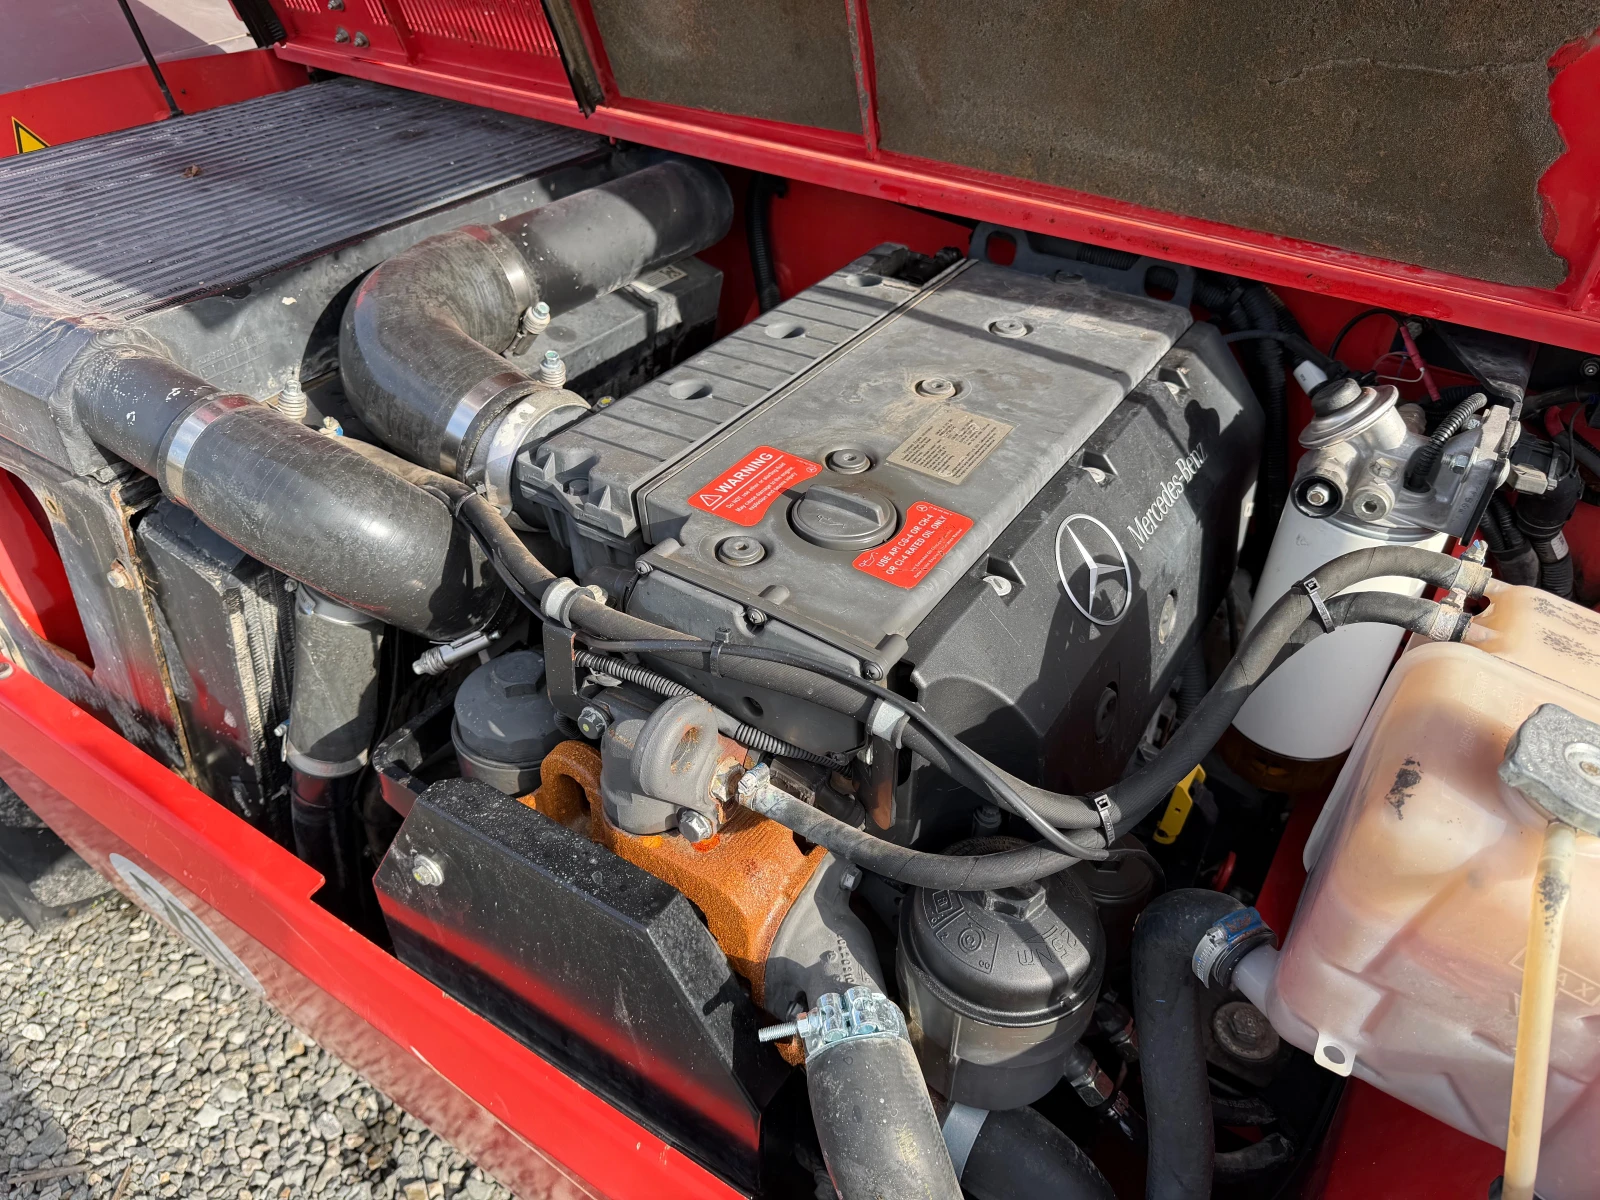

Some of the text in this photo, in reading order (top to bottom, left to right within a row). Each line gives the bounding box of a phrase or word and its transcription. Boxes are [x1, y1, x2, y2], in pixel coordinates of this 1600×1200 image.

[715, 452, 774, 493] WARNING
[733, 495, 742, 505] NOT
[1127, 442, 1208, 550] Mercedes-Benz
[876, 513, 934, 568] USE API CG-4 OR CH-4
[885, 565, 898, 575] OR
[894, 554, 909, 567] CI-4
[904, 537, 926, 556] RATED
[922, 529, 935, 539] OIL
[931, 515, 948, 530] ONLY
